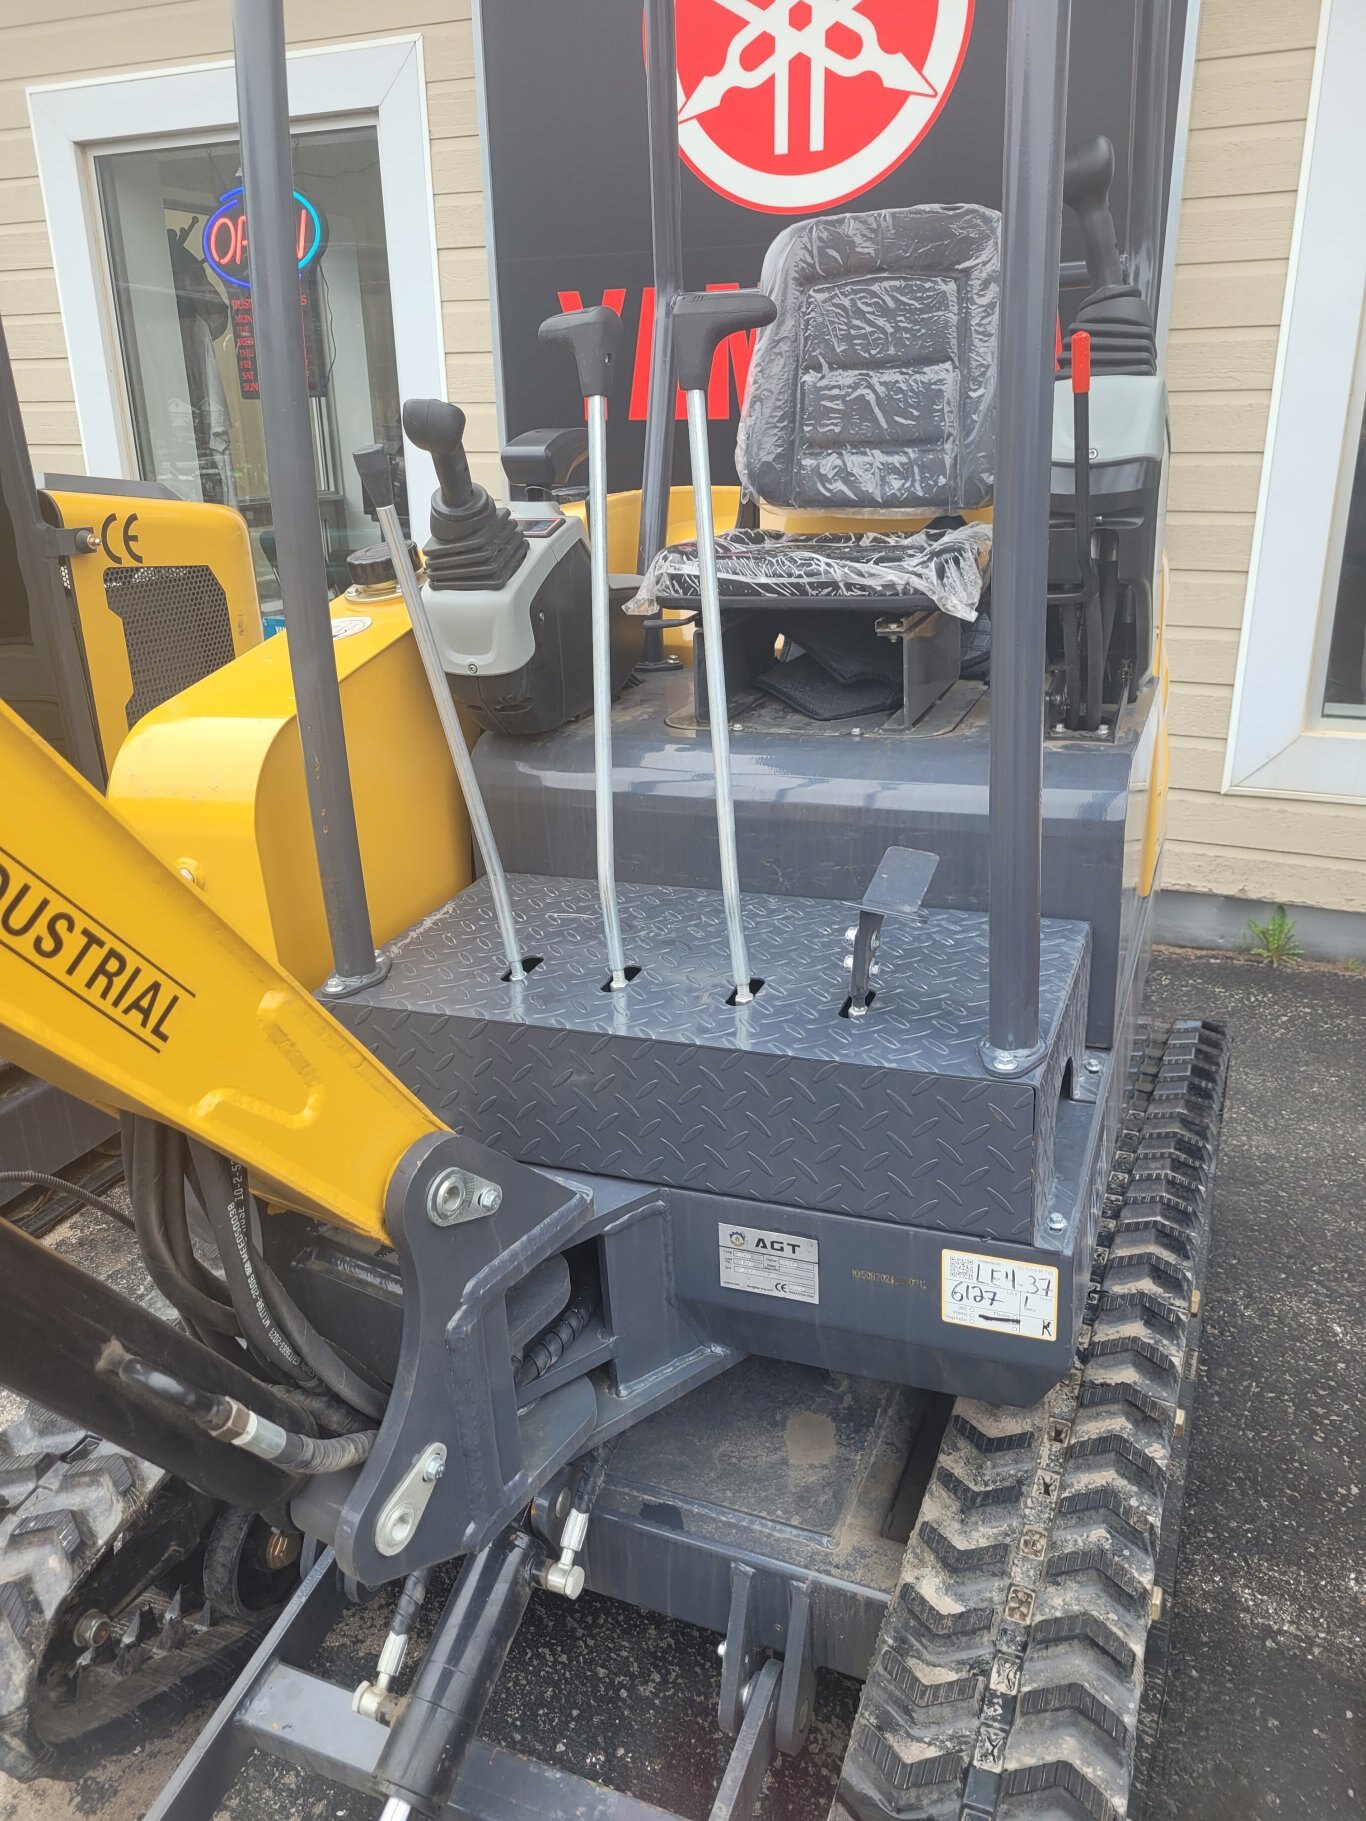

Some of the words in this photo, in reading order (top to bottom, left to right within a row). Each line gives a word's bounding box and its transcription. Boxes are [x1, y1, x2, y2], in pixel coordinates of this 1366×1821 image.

[210, 209, 307, 264] OP
[243, 383, 259, 391] SUN
[101, 512, 143, 565] CE
[0, 863, 180, 1043] USTRIAL
[754, 1237, 801, 1255] AGT
[950, 1280, 1005, 1307] 6127
[1041, 1319, 1053, 1337] K
